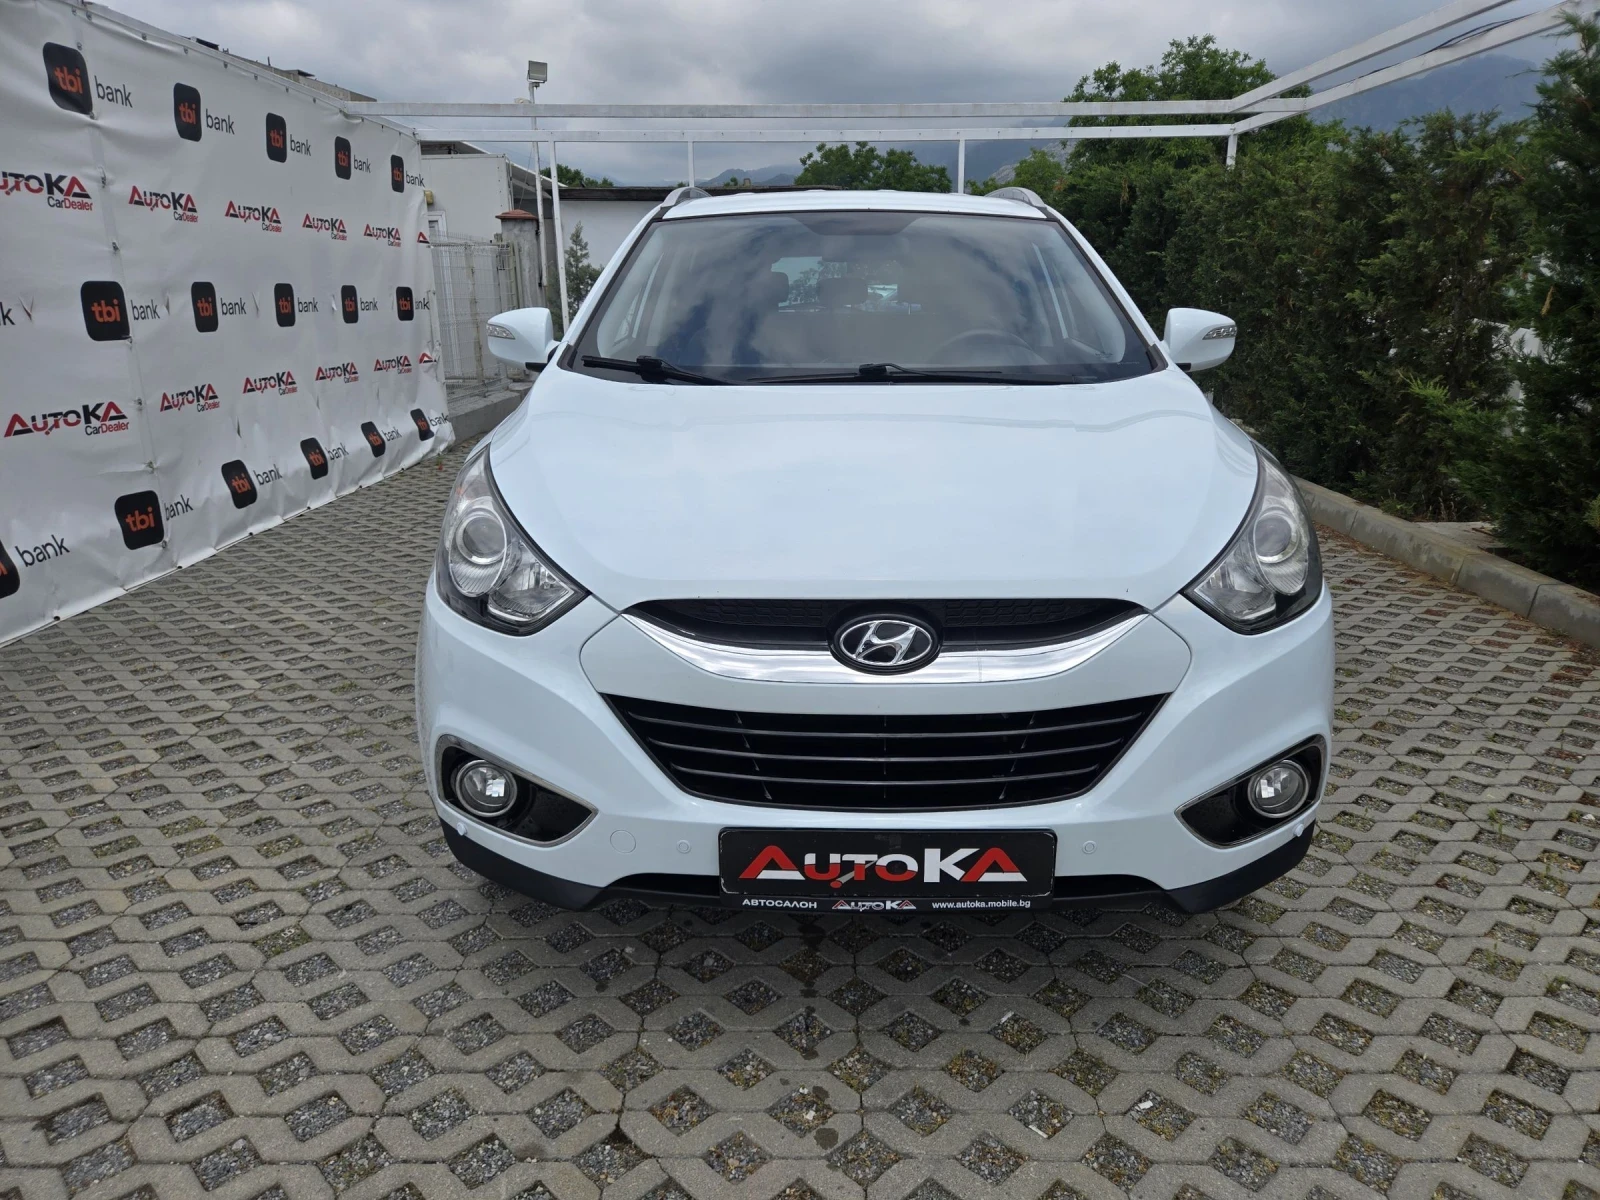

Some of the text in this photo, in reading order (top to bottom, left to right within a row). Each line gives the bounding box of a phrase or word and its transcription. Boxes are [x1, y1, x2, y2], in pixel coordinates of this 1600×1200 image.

[54, 66, 133, 108] tbi bank
[179, 102, 235, 135] tbi bank
[270, 129, 311, 156] tbi bank
[337, 150, 371, 173] tbi bank
[0, 171, 92, 199] TOKA
[405, 171, 425, 187] bank
[47, 196, 93, 211] CarDealer
[128, 185, 198, 213] AUTOKA
[224, 200, 282, 224] AUTOKA
[91, 299, 160, 323] tbi bank
[196, 297, 247, 316] tbi bank
[278, 297, 319, 313] tbi bank
[360, 298, 378, 311] bank
[243, 371, 297, 394] AUTOKA
[160, 383, 218, 412] AUTOKA
[4, 401, 128, 437] AUTOKA
[85, 420, 130, 436] CarDealer
[428, 412, 450, 427] bank
[383, 427, 402, 441] bank
[309, 442, 350, 466] tbi bank
[232, 464, 283, 494] tbi bank
[125, 494, 194, 532] tbi bank
[15, 534, 70, 567] bank
[738, 845, 1028, 888] AUTOKA
[742, 898, 817, 909] АВТОСАЛОН
[832, 899, 917, 911] AUTOKA
[932, 899, 1031, 909] www.autoka.mobile.bg
